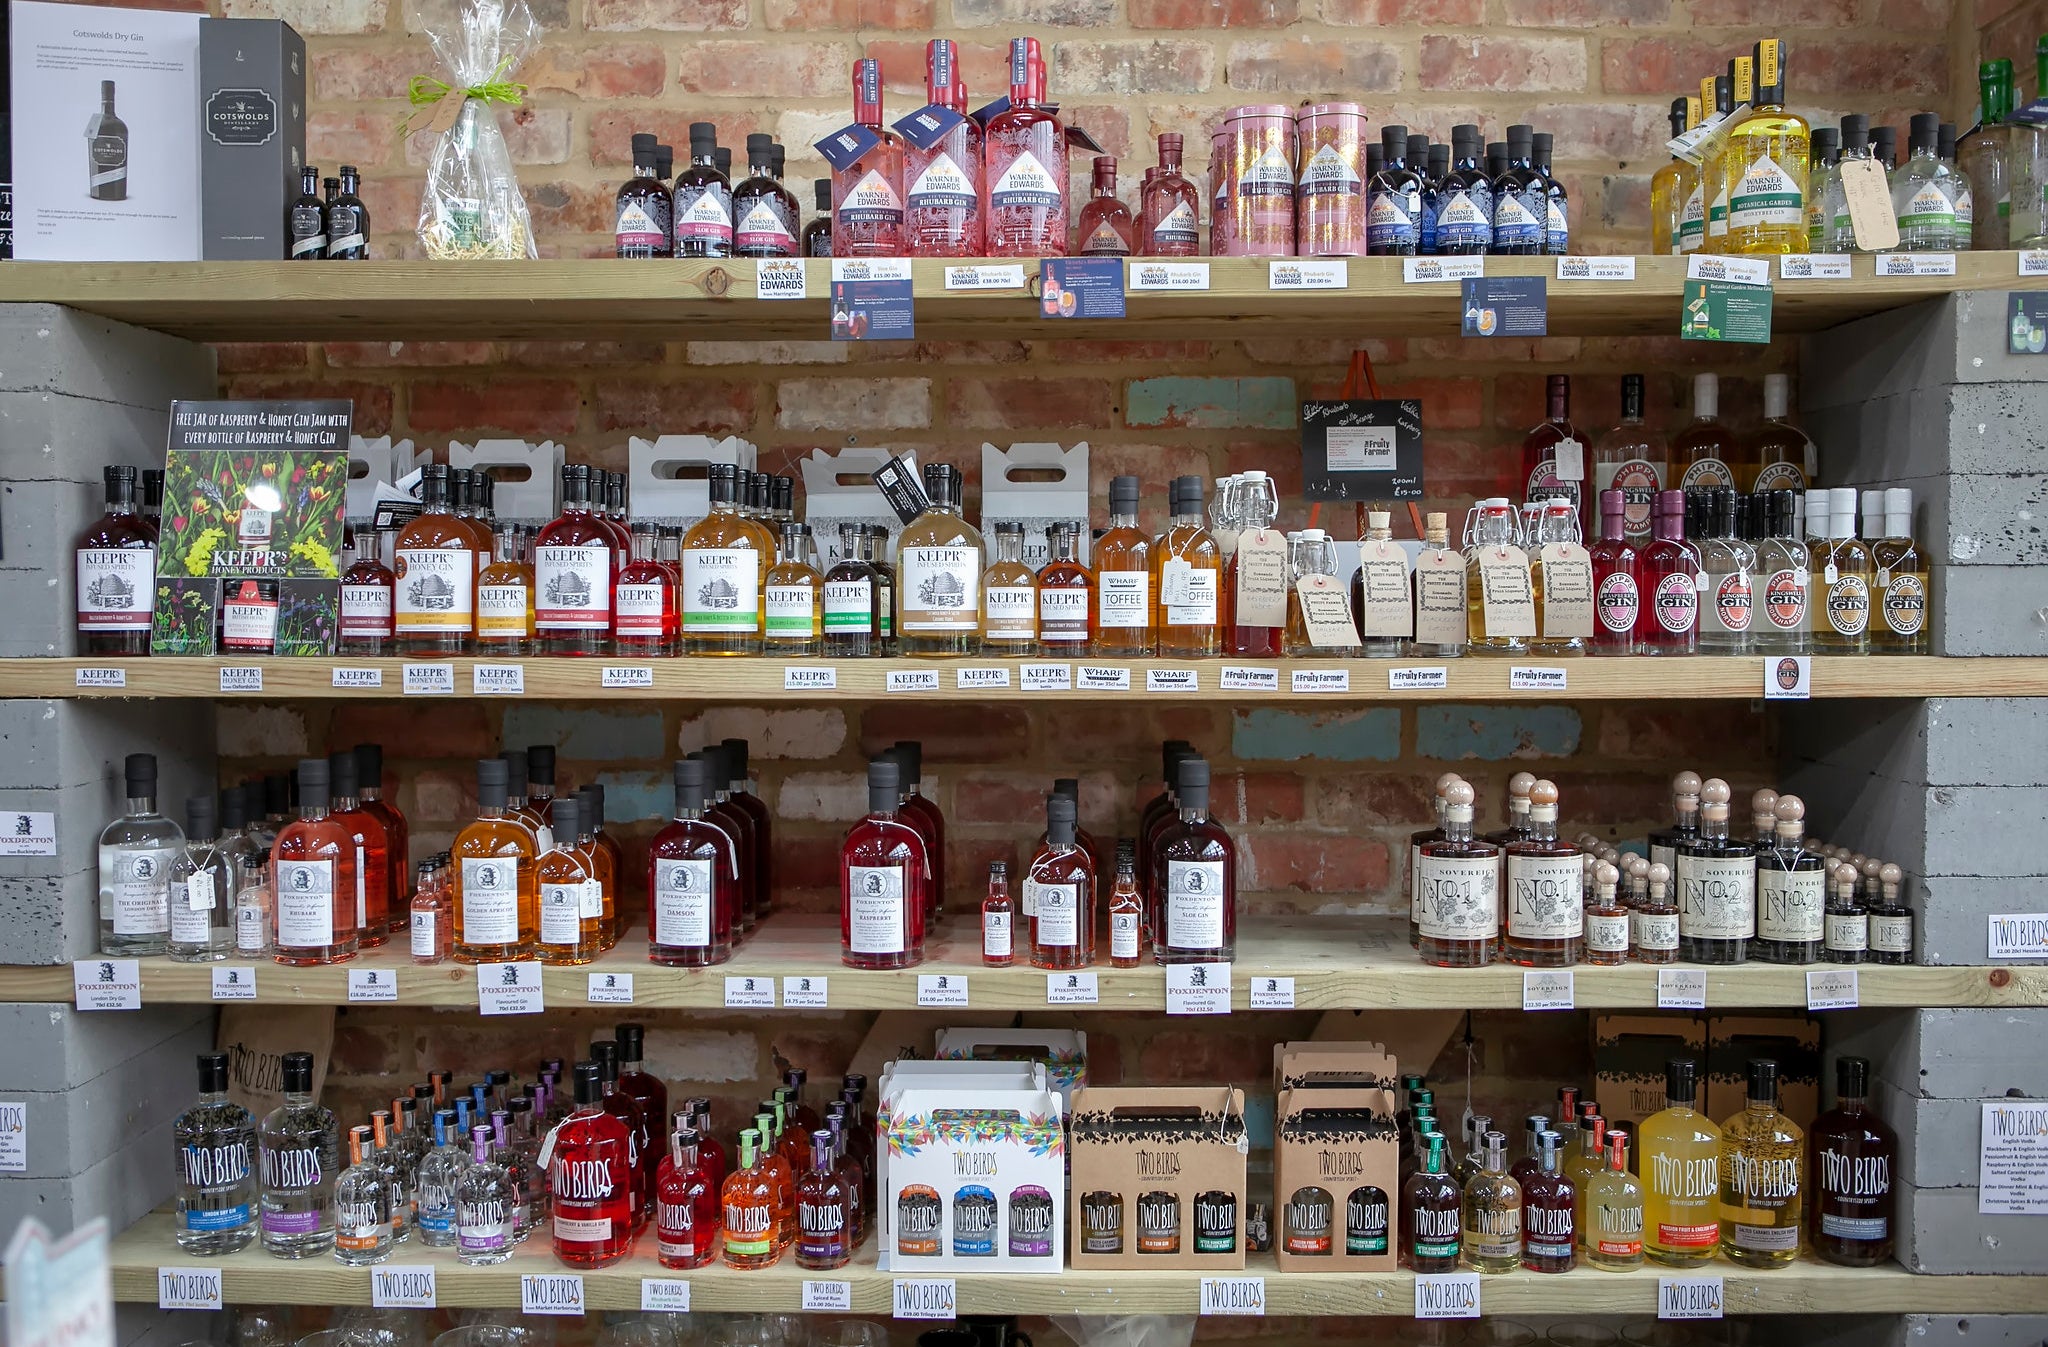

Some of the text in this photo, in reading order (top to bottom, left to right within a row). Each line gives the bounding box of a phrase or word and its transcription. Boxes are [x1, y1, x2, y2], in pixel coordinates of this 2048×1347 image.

[73, 29, 144, 42] Cotswolds Dry Gin
[213, 113, 269, 121] COTSWOLDS
[926, 175, 960, 183] WARNER
[1312, 171, 1344, 179] EDWARDS
[1746, 176, 1782, 185] WARNER
[926, 183, 960, 191] EDWARDS
[1337, 185, 1350, 193] GIN
[1746, 183, 1782, 192] EDWARDS
[1767, 200, 1793, 208] GARDEN
[1914, 205, 1944, 213] EDWARDS
[1743, 209, 1772, 217] HONEYBEE
[1905, 218, 1941, 226] ELDERFLOWER
[1611, 263, 1620, 271] Dry
[760, 272, 802, 280] WARNER
[760, 280, 803, 290] EDWARDS
[1400, 400, 1420, 419] Vodka
[176, 413, 348, 427] FREE JAR OF RASPBERRY & HONEY GIN JAM WITH
[184, 431, 336, 444] EVERY BOTTLE OF RASPBERRY & HONEY GIN
[1369, 440, 1390, 449] Fruity
[86, 554, 136, 564] KEEPR'S
[213, 551, 287, 566] KEEPR'S
[410, 553, 454, 563] KEEPR'S
[917, 550, 967, 562] KEEPR'S
[212, 566, 241, 574] HONEY
[242, 566, 286, 574] PRODUCTS
[409, 562, 453, 571] HONEY GIN
[1604, 576, 1633, 590] PHIPPS
[1891, 579, 1920, 593] PHIPPS
[1105, 594, 1141, 604] TOFFEE
[1603, 598, 1633, 606] GIN
[1889, 600, 1921, 610] GIN
[1600, 607, 1636, 629] NORTHAMPTON
[1888, 610, 1923, 631] NORTHAMPTON
[1084, 668, 1123, 676] WHARF
[1439, 868, 1495, 876] SOVEREIGN
[667, 909, 695, 917] DAMSON
[78, 983, 137, 991] FOXDENTON
[1992, 1110, 2048, 1136] TWO BIRDS
[182, 1142, 250, 1185] TWO BIRDS
[952, 1151, 998, 1176] TWO BIRDS
[1136, 1152, 1181, 1174] TWO BIRDS
[1651, 1155, 1719, 1197] TWO BIRDS
[1820, 1151, 1890, 1194] TWO BIRDS
[202, 1209, 218, 1217] LONDON
[219, 1208, 228, 1216] DRY
[799, 1203, 844, 1232] TWO BIRDS
[524, 1277, 580, 1304] TWO BIRDS
[1418, 1281, 1475, 1308] TWO BIRDS
[554, 1304, 582, 1312] Harborough
